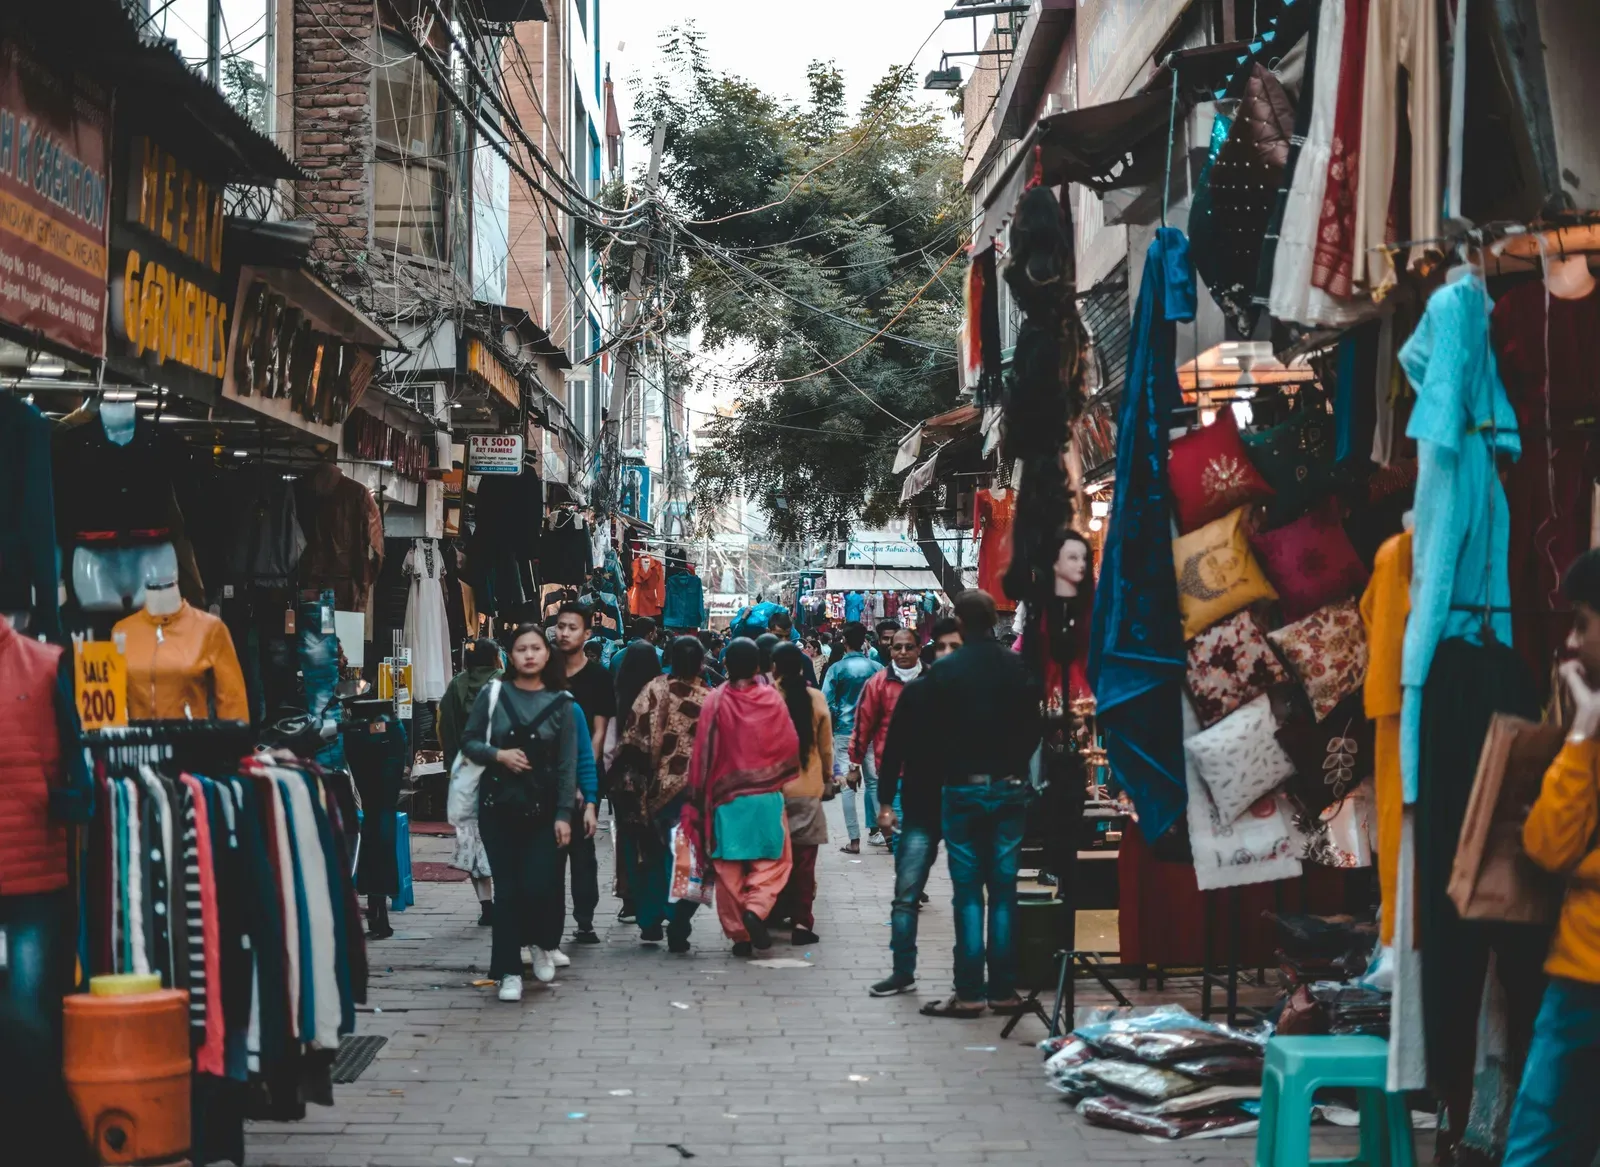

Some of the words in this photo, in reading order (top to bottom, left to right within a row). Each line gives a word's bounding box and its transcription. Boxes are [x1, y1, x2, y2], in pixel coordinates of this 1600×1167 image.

[0, 201, 36, 235] NDIAN
[73, 240, 102, 273] WEAR
[46, 295, 60, 317] New
[60, 301, 76, 325] Delhi
[123, 248, 227, 379] GARMENTS
[472, 437, 478, 446] R
[482, 437, 488, 446] K
[491, 437, 516, 447] SOOD
[885, 545, 908, 553] Fabrics
[82, 659, 109, 683] SALE
[82, 689, 115, 722] 200
